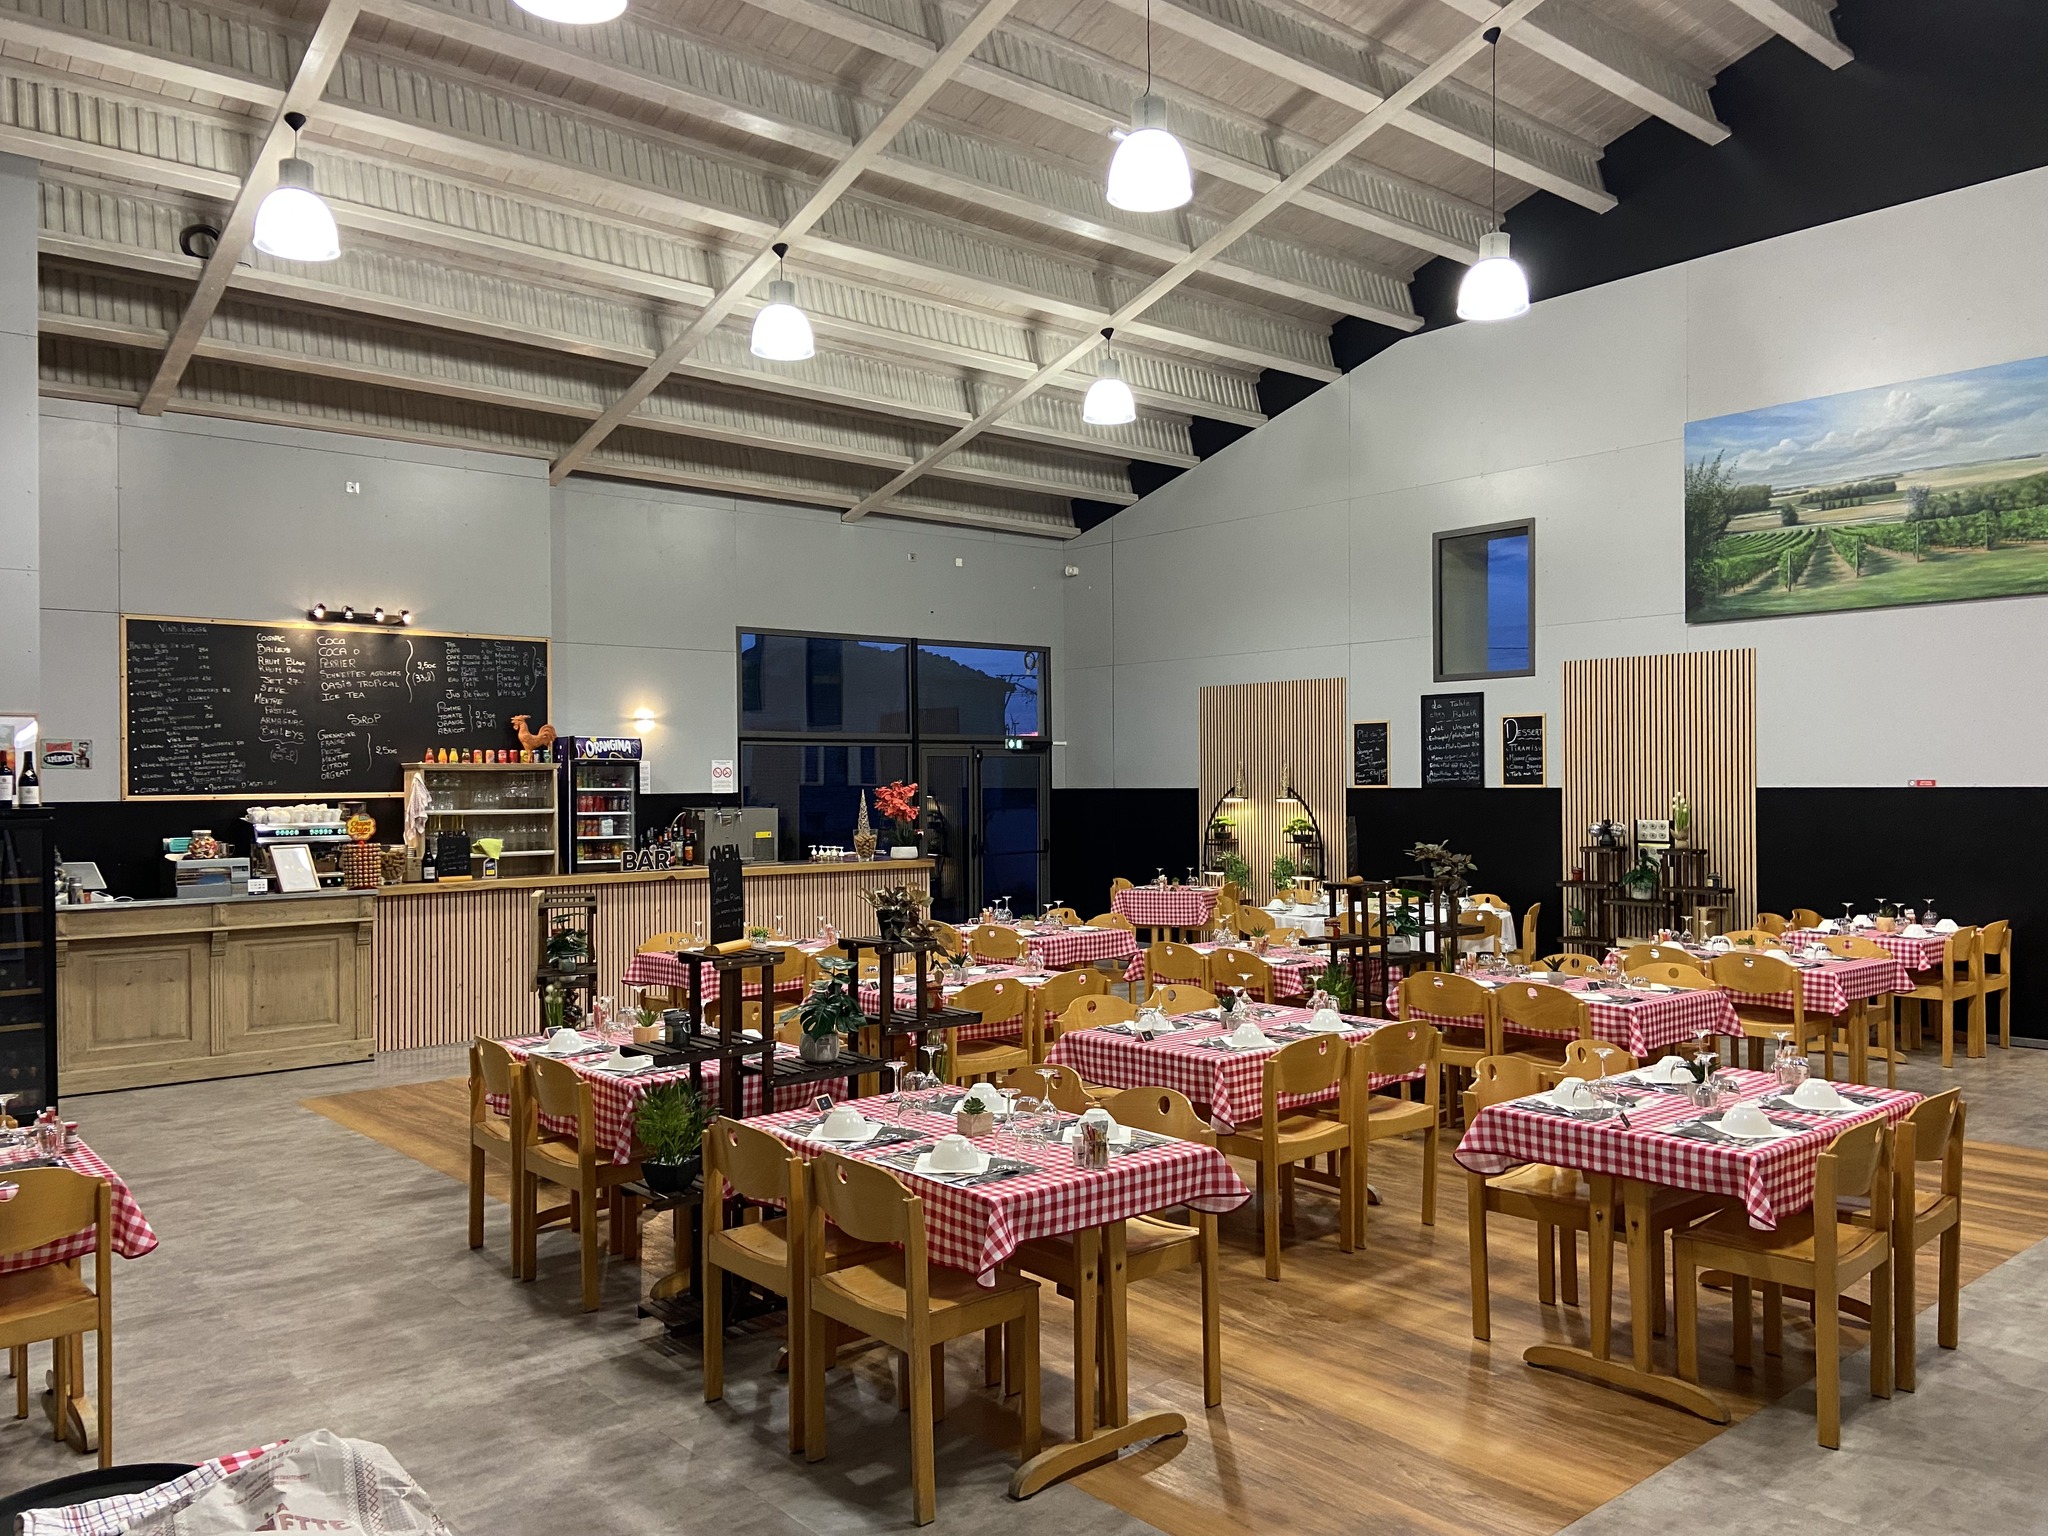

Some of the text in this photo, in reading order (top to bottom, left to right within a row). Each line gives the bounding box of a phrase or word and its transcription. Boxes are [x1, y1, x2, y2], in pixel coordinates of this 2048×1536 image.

[318, 647, 347, 657] COCA
[345, 691, 366, 699] TEA
[586, 739, 632, 758] ORANGINA
[321, 762, 349, 772] CITRON
[620, 849, 671, 872] BAR
